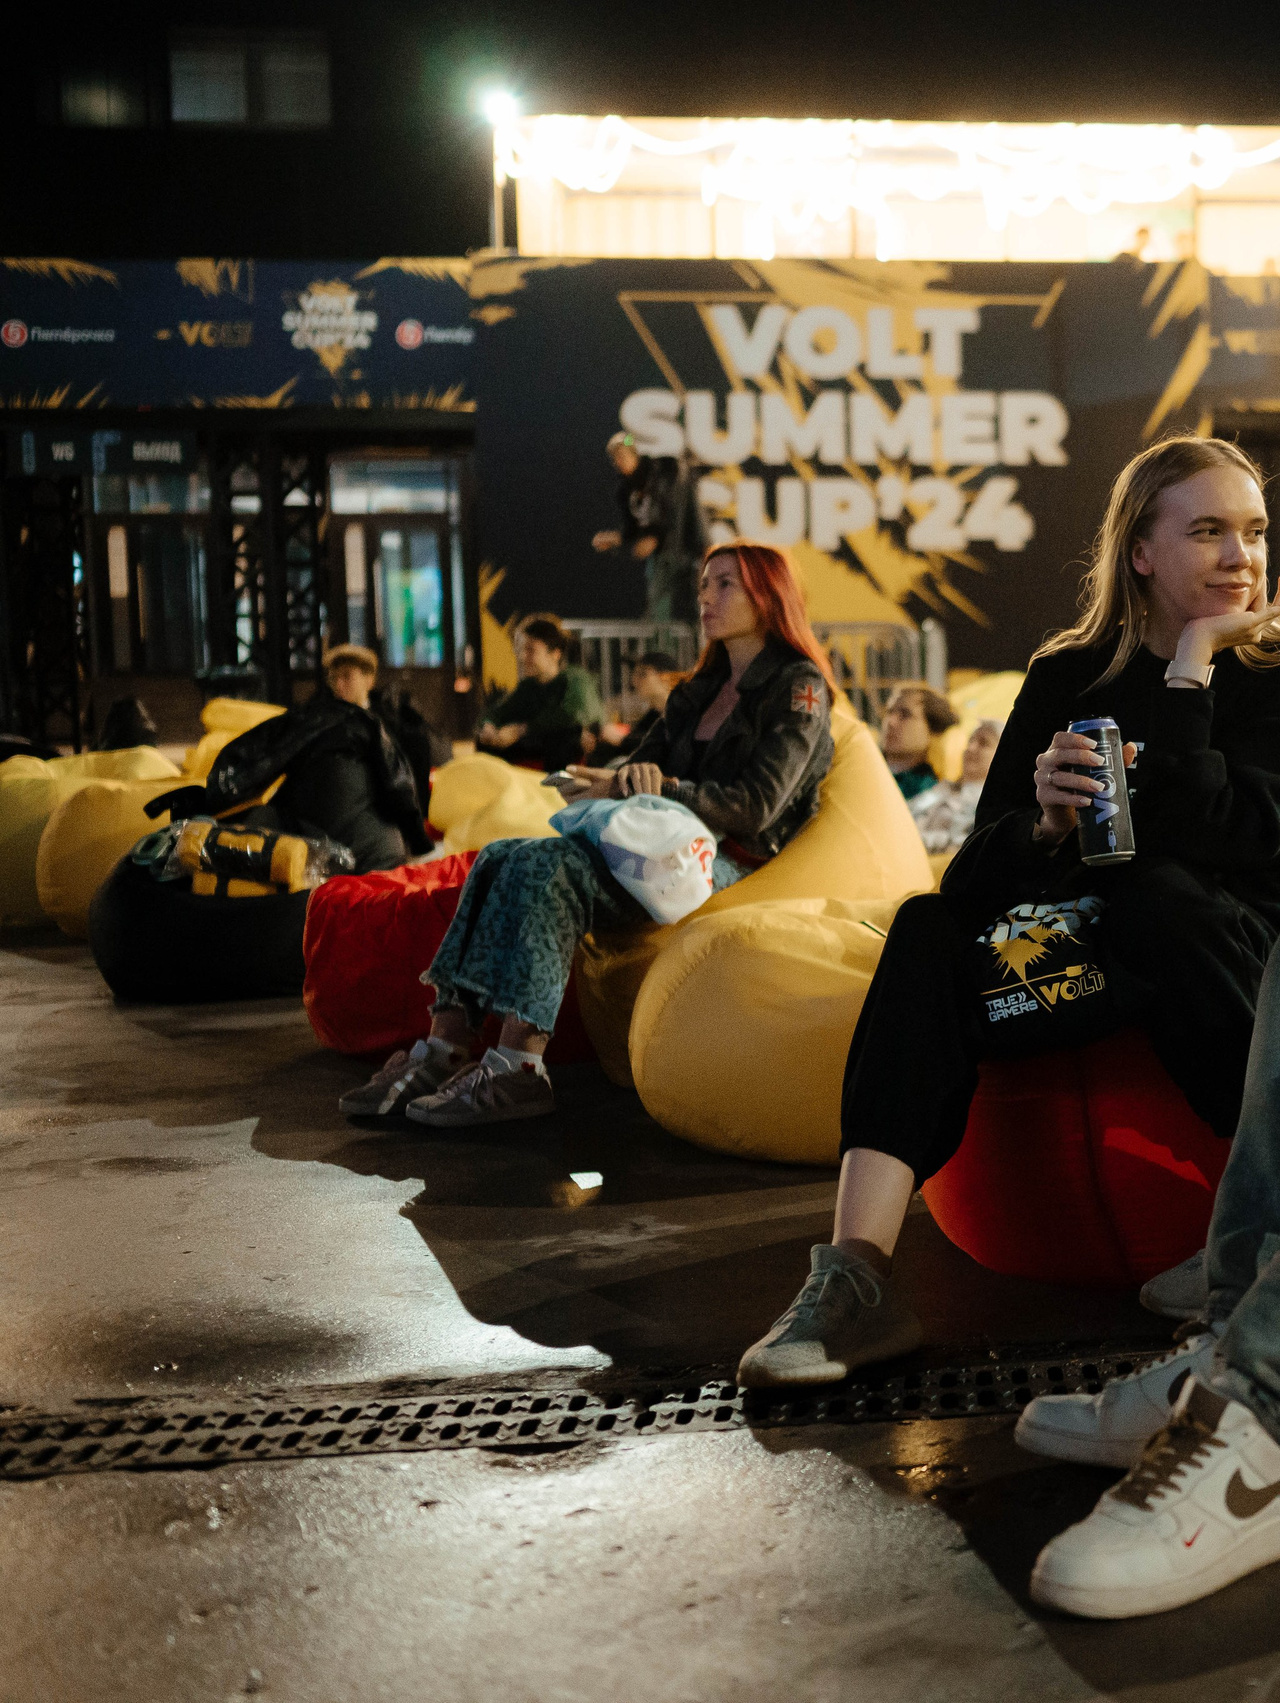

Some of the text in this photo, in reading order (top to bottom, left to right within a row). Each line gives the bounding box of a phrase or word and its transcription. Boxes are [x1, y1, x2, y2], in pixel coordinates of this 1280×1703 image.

[709, 305, 982, 380] VOLT
[620, 389, 1070, 467] SUMMER
[988, 1000, 1039, 1022] GAMERS
[1039, 971, 1104, 1005] VOLT
